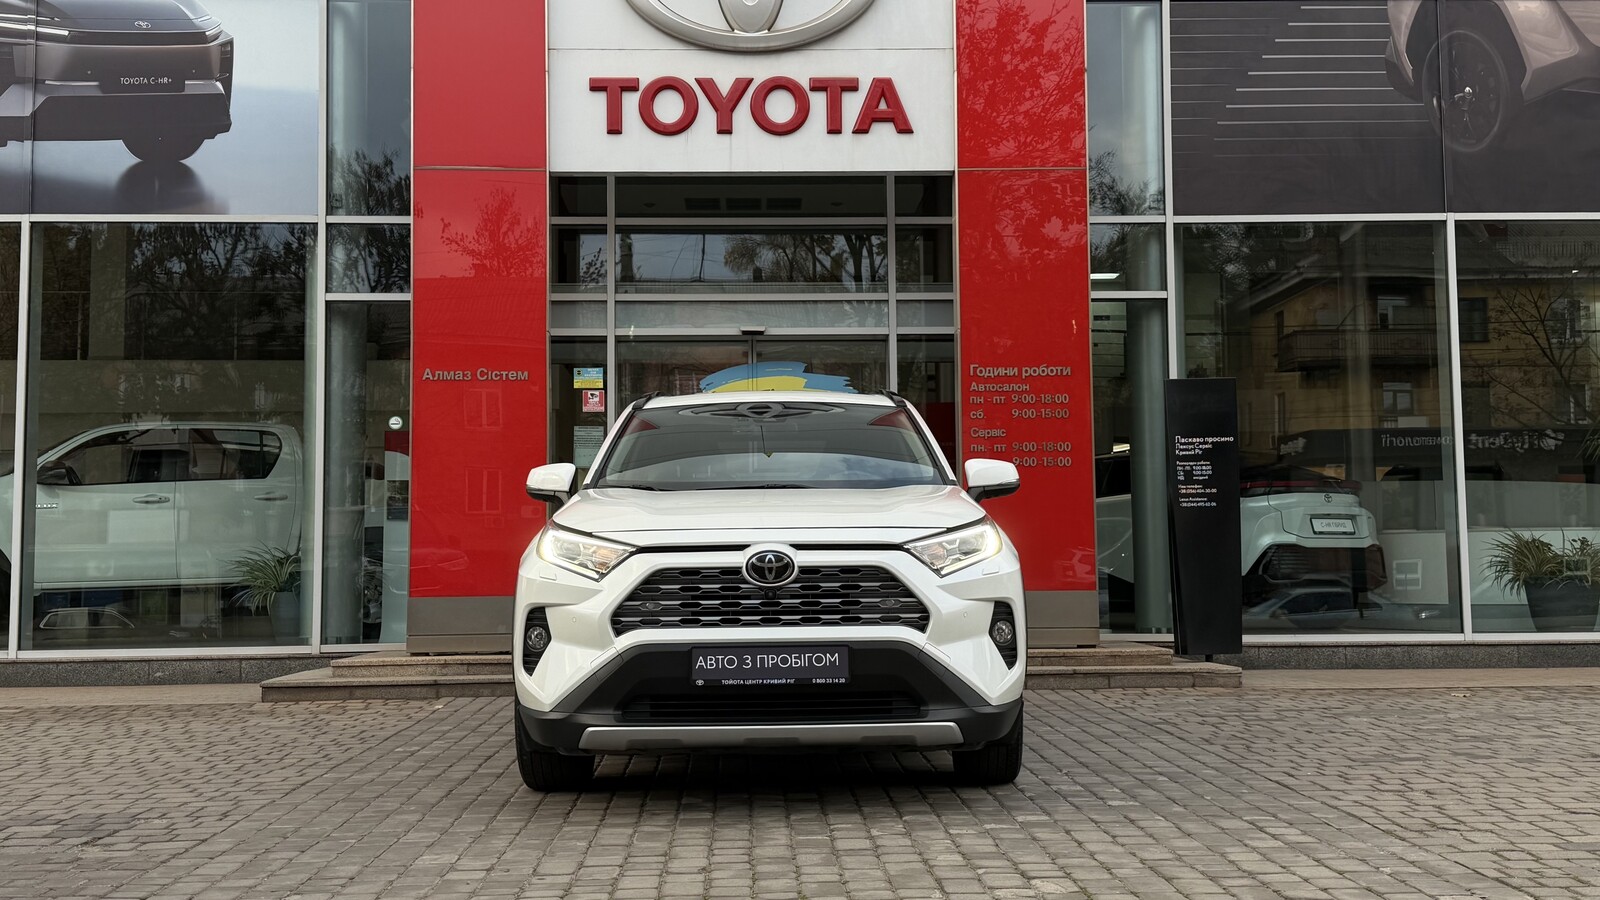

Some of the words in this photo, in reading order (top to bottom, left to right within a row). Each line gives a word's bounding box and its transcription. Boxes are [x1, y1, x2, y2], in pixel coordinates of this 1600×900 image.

[120, 77, 148, 85] TOYOTA
[150, 76, 172, 85] C-HR+
[589, 76, 914, 136] TOYOTA
[422, 368, 472, 381] Алмаз
[476, 367, 529, 381] Сістем
[969, 364, 1019, 378] Години
[1021, 363, 1071, 379] роботи
[969, 381, 1030, 392] Автосалон
[1011, 393, 1070, 404] 9:00-18:00
[970, 408, 987, 419] сб.
[1011, 408, 1070, 419] 9:00-15:00
[970, 427, 1007, 439] Сервіс
[695, 655, 738, 669] АВТО
[742, 655, 752, 669] З
[756, 653, 840, 668] ПРОБІГОМ
